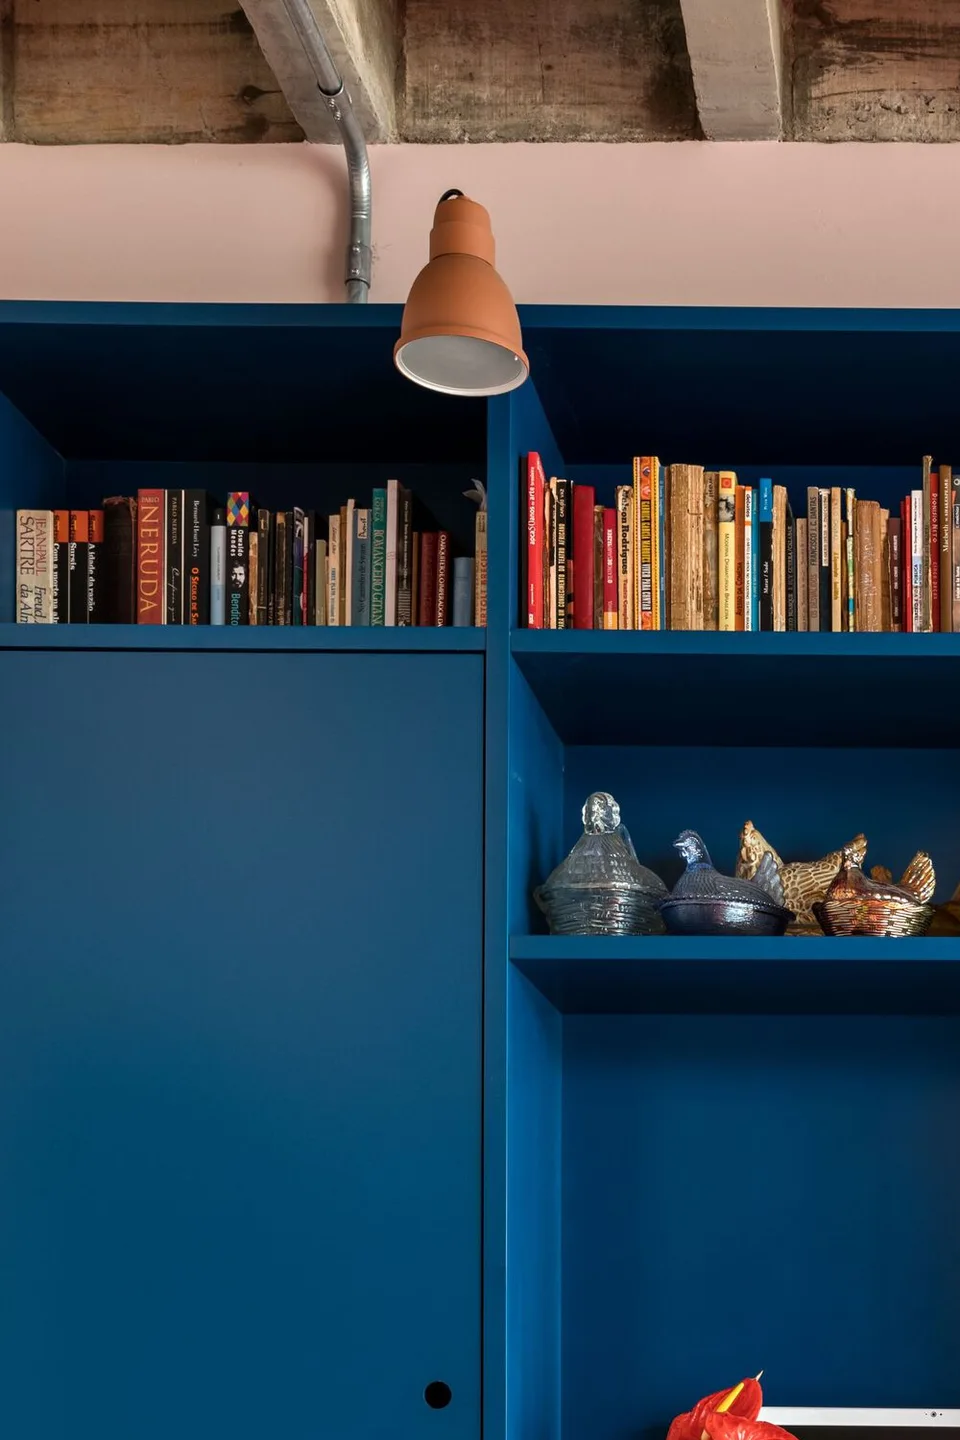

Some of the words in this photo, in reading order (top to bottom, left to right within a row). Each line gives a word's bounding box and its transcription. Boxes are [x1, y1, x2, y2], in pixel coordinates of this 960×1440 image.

[20, 515, 35, 576] SARTRE
[53, 542, 61, 561] Com
[70, 542, 78, 570] Sursis
[139, 505, 160, 614] NERUDA
[371, 529, 384, 591] ROMANCEIRO
[620, 524, 630, 575] Rodrigues
[191, 567, 199, 575] O
[20, 583, 32, 599] da
[230, 592, 241, 625] Bendito
